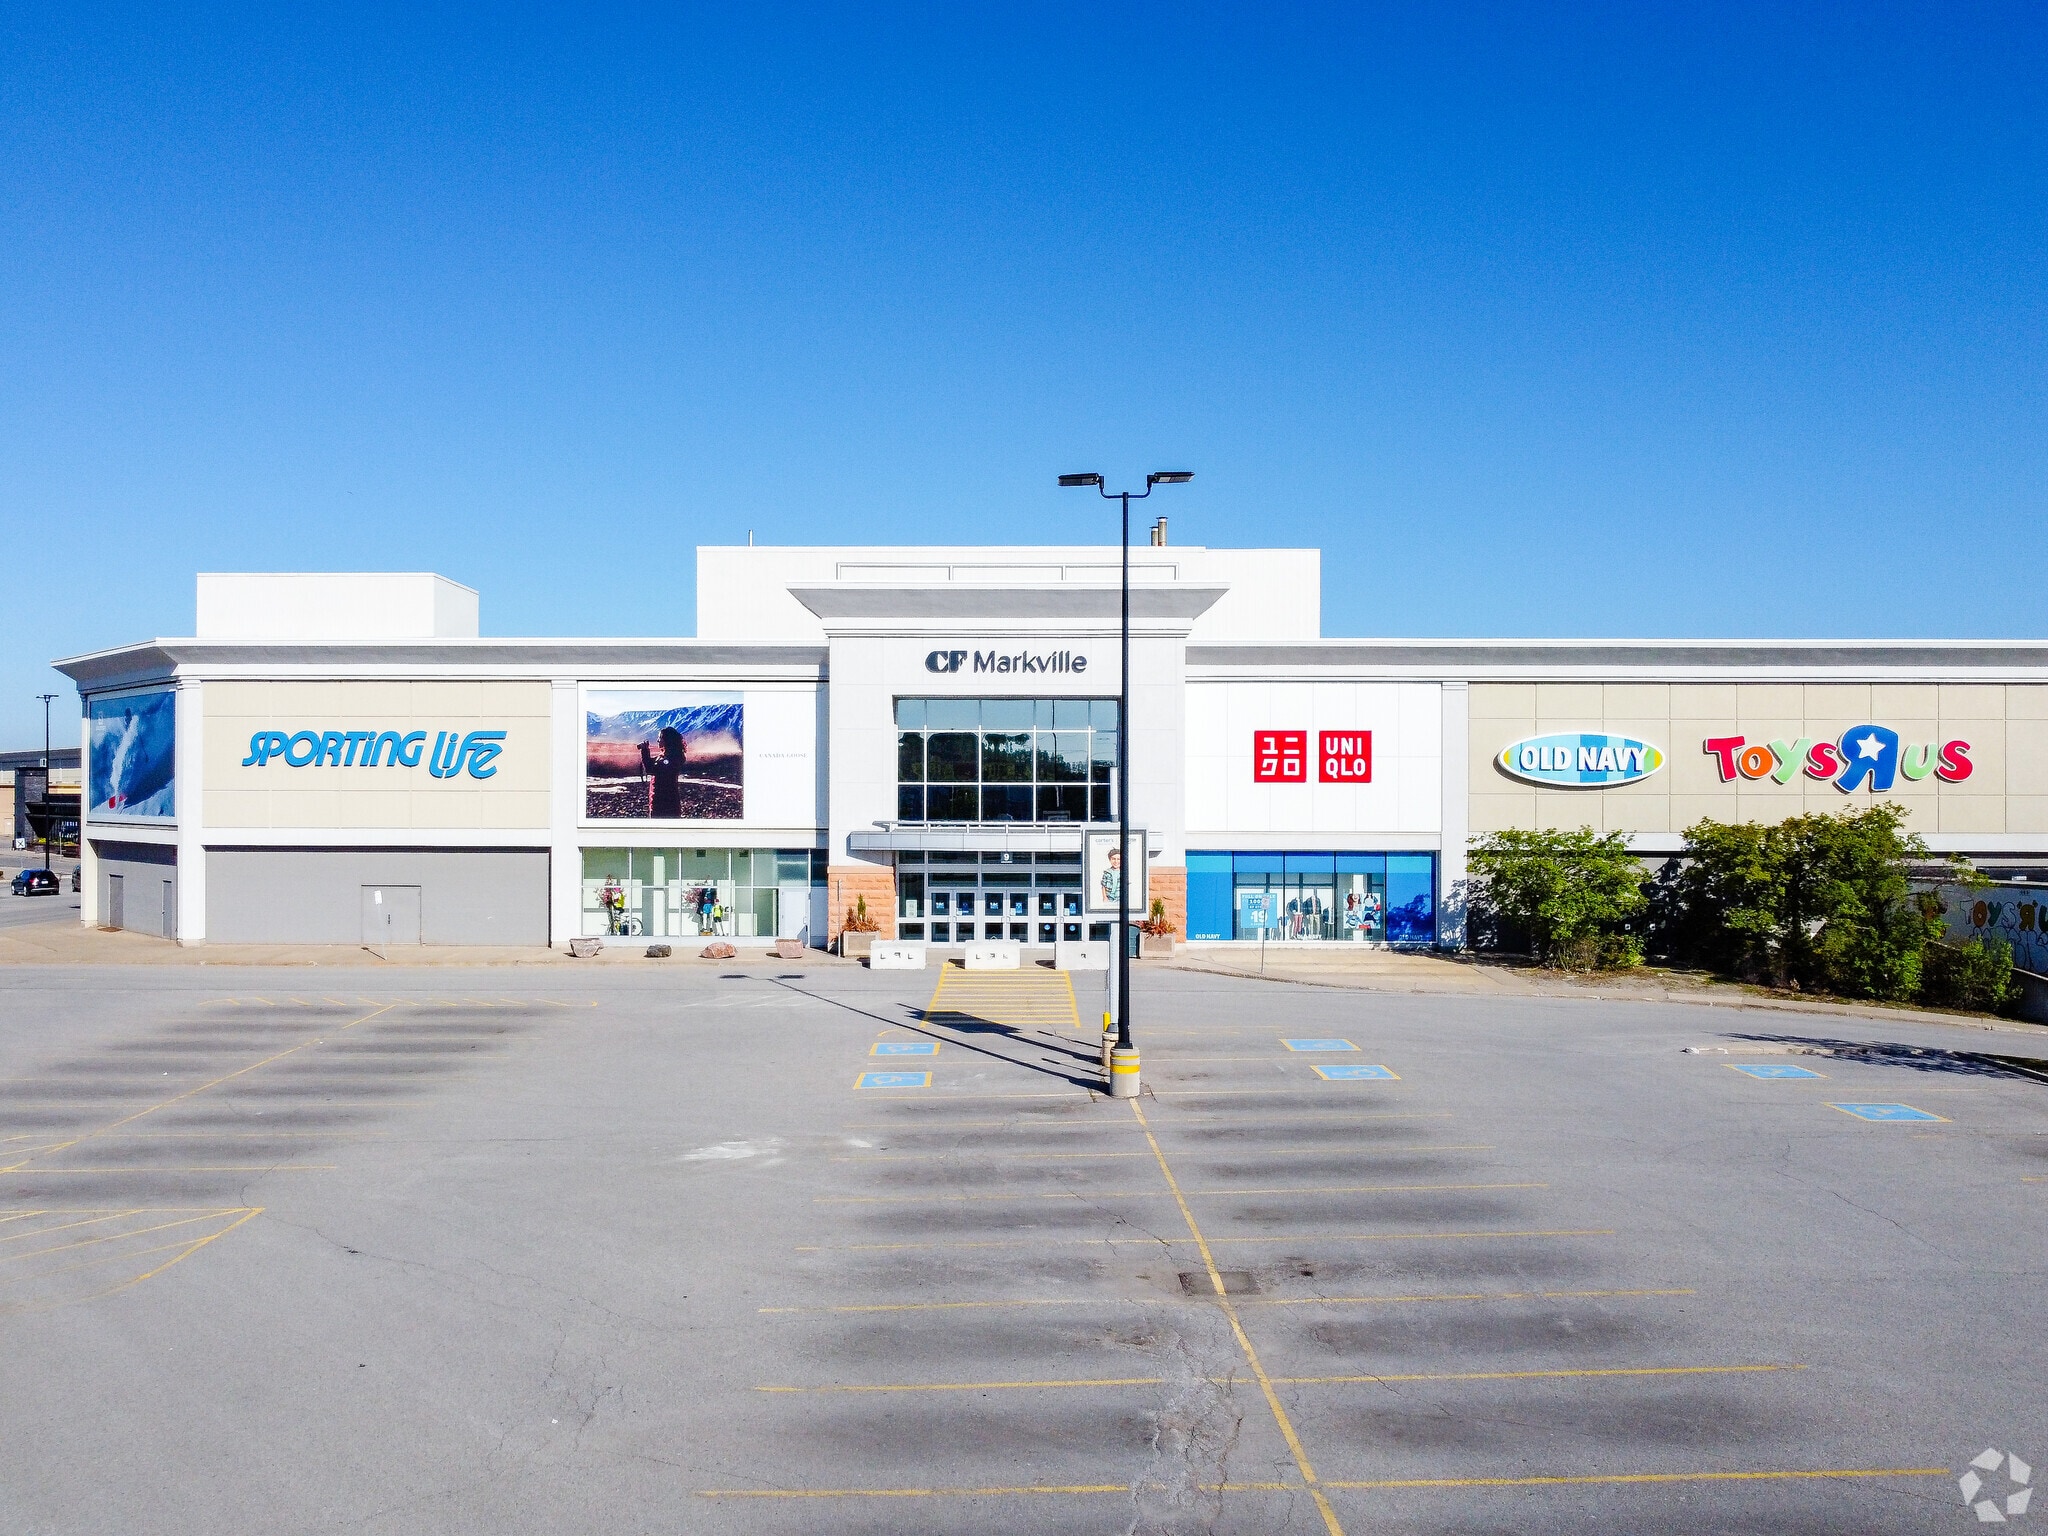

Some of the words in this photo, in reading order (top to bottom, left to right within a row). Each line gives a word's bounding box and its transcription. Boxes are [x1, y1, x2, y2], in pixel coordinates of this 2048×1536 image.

[925, 650, 967, 673] CF
[974, 650, 1088, 674] Markville
[1325, 737, 1362, 755] UNI
[1325, 757, 1366, 779] QLO
[1519, 745, 1573, 771] OLD
[1577, 745, 1649, 772] NAVY
[1003, 853, 1010, 861] 9
